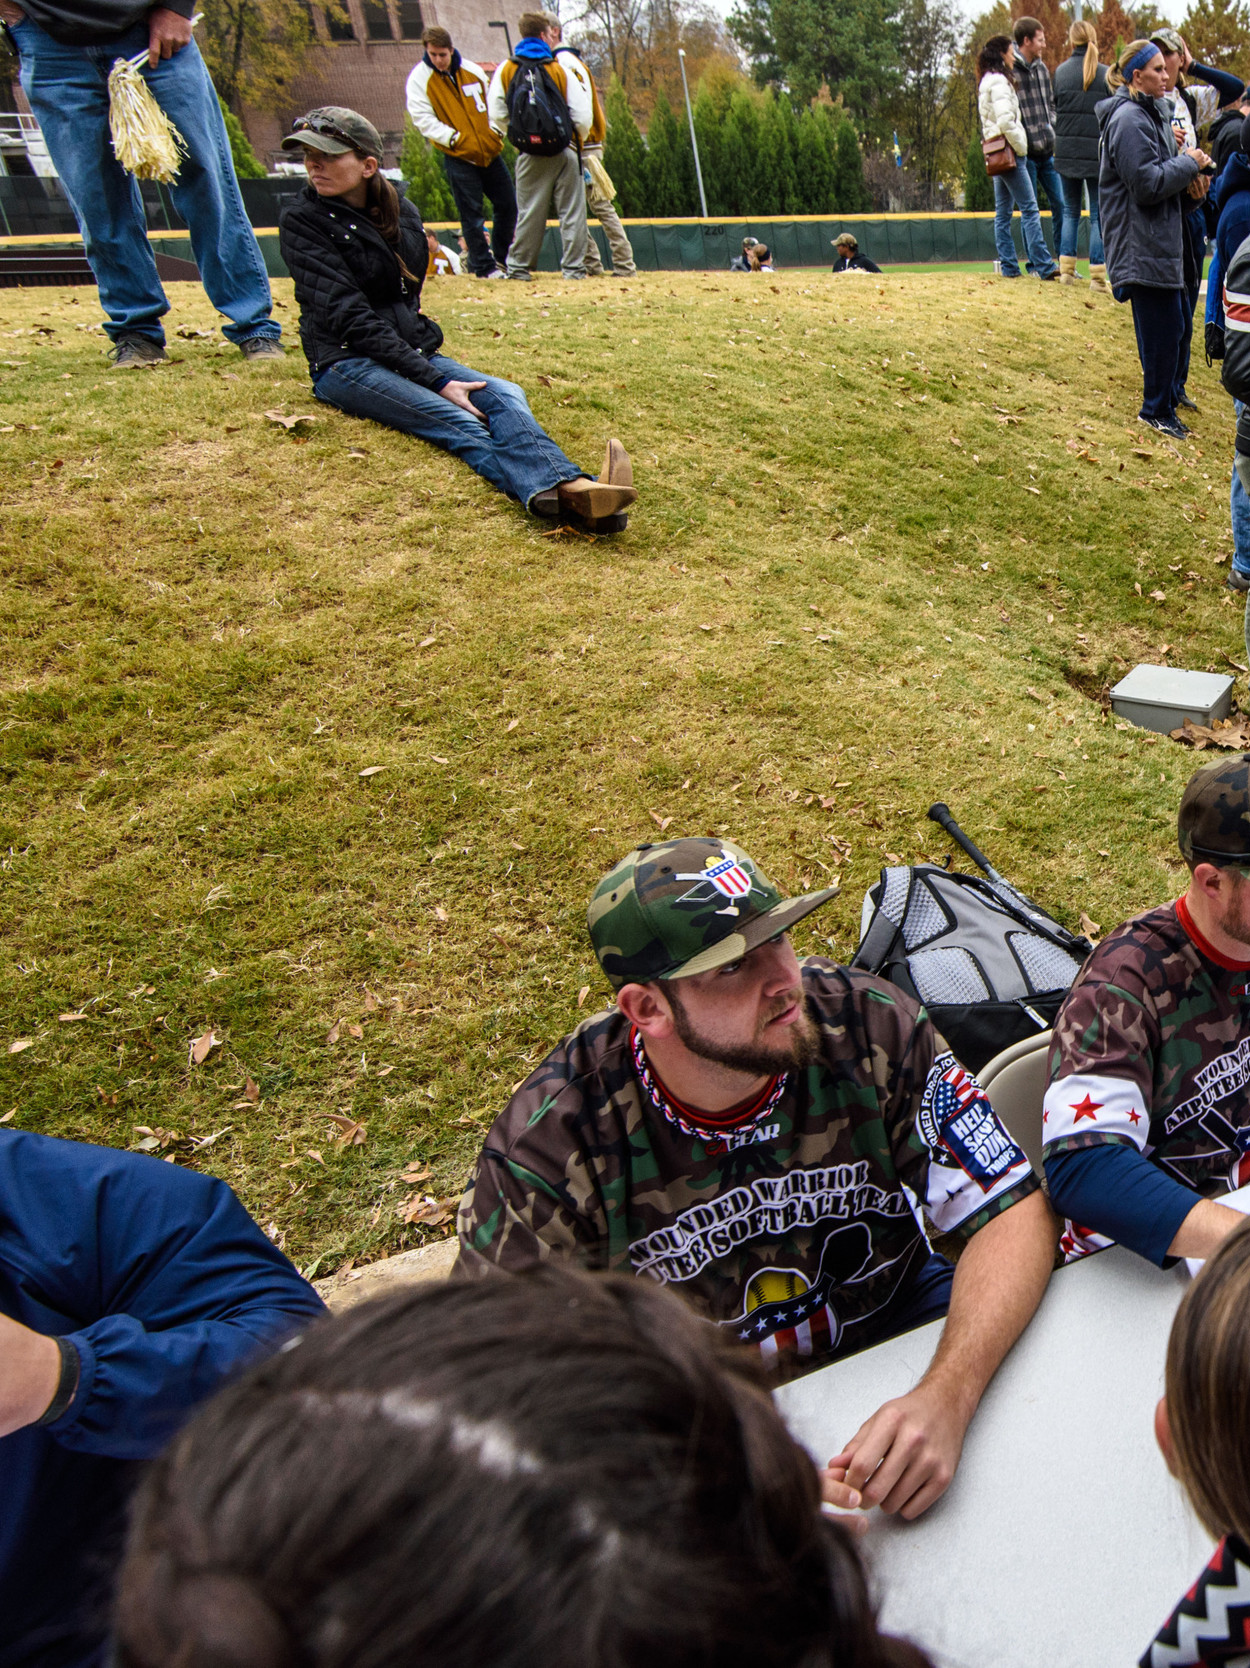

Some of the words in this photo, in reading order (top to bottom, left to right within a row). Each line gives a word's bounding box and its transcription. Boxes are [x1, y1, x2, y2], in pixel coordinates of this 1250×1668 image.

[462, 82, 487, 113] T
[704, 225, 725, 236] 220
[1164, 1070, 1245, 1134] AMPUTEE
[920, 1110, 938, 1147] RMED
[974, 1129, 1010, 1168] OUR
[629, 1187, 753, 1266] WOUNDED
[752, 1160, 868, 1206] WARRIOR
[640, 1238, 713, 1287] UTEE
[708, 1191, 849, 1258] SOFTBALL
